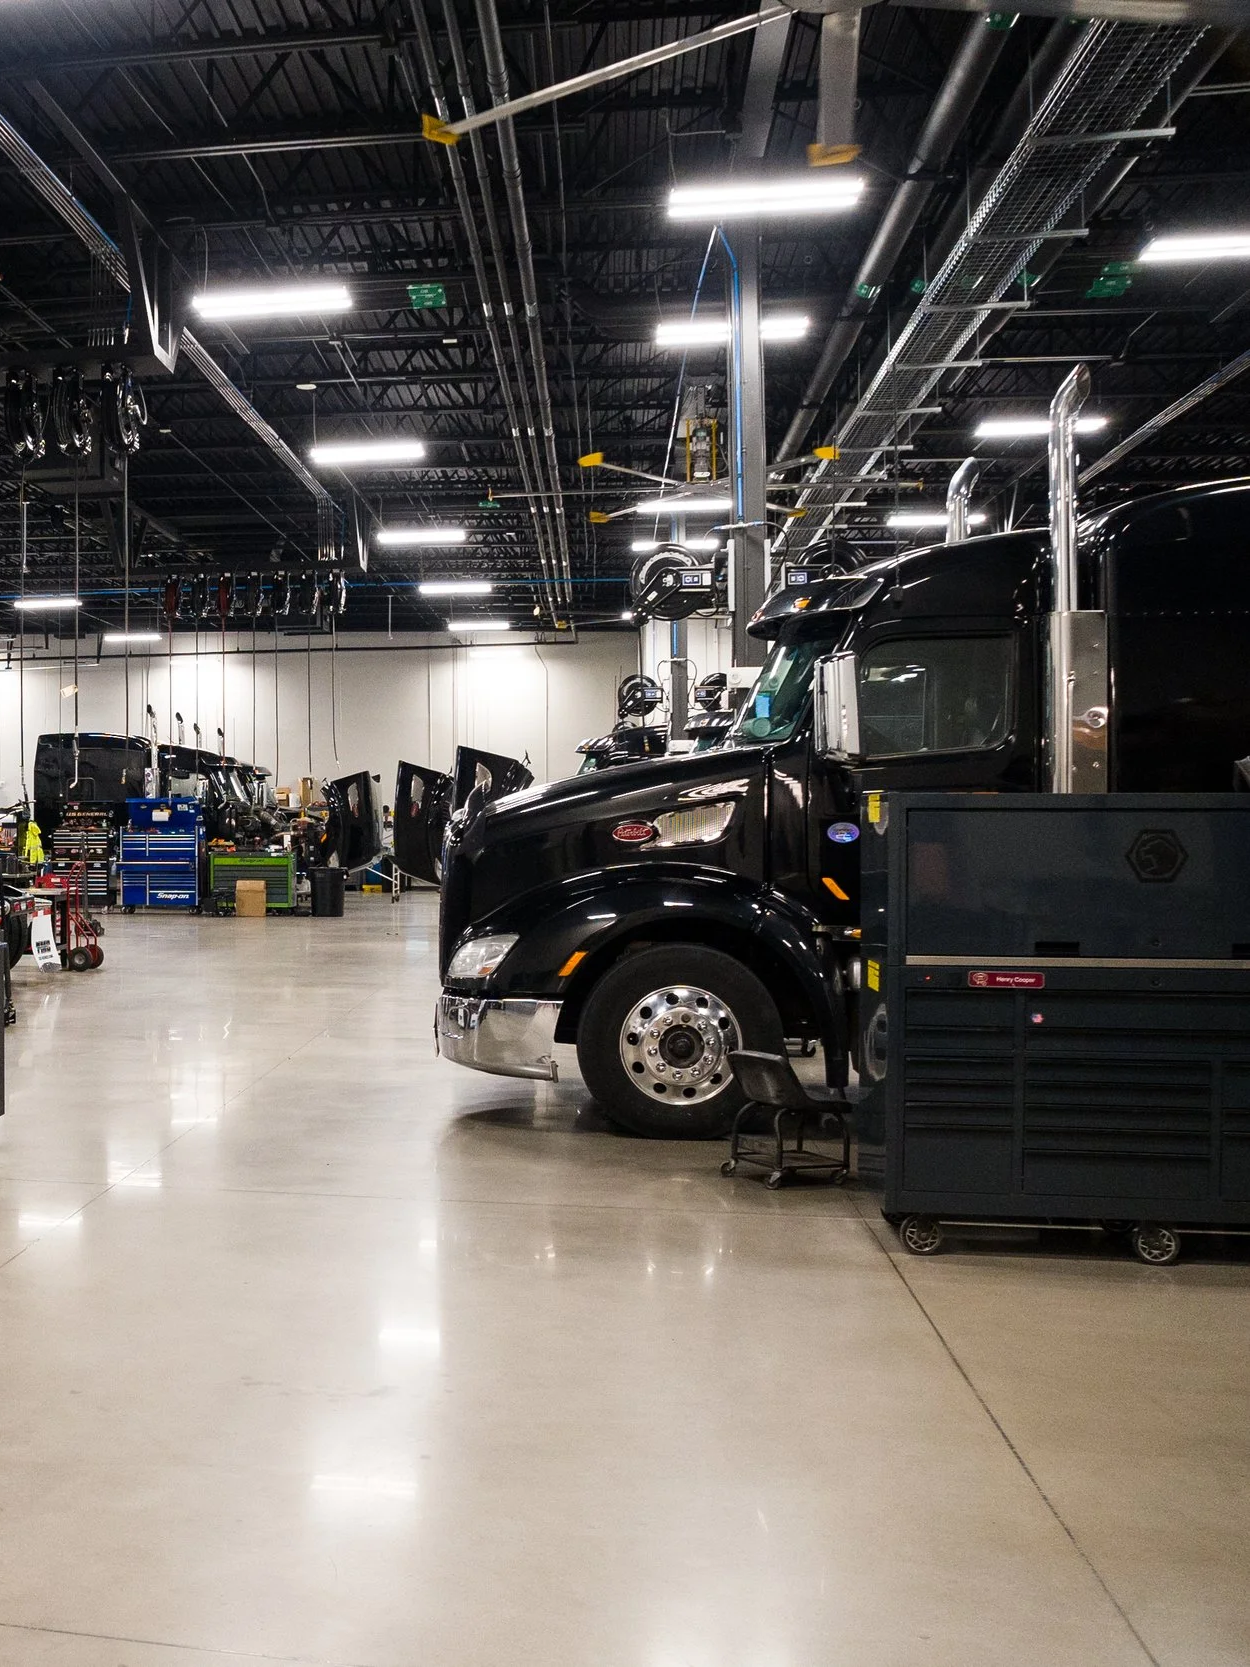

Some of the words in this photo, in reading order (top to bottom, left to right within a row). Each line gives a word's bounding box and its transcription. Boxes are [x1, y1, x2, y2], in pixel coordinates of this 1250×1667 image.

[617, 827, 649, 837] Peterbilt
[156, 892, 190, 900] Snap-on
[996, 976, 1013, 984] Henry
[1014, 976, 1036, 984] Cooper
